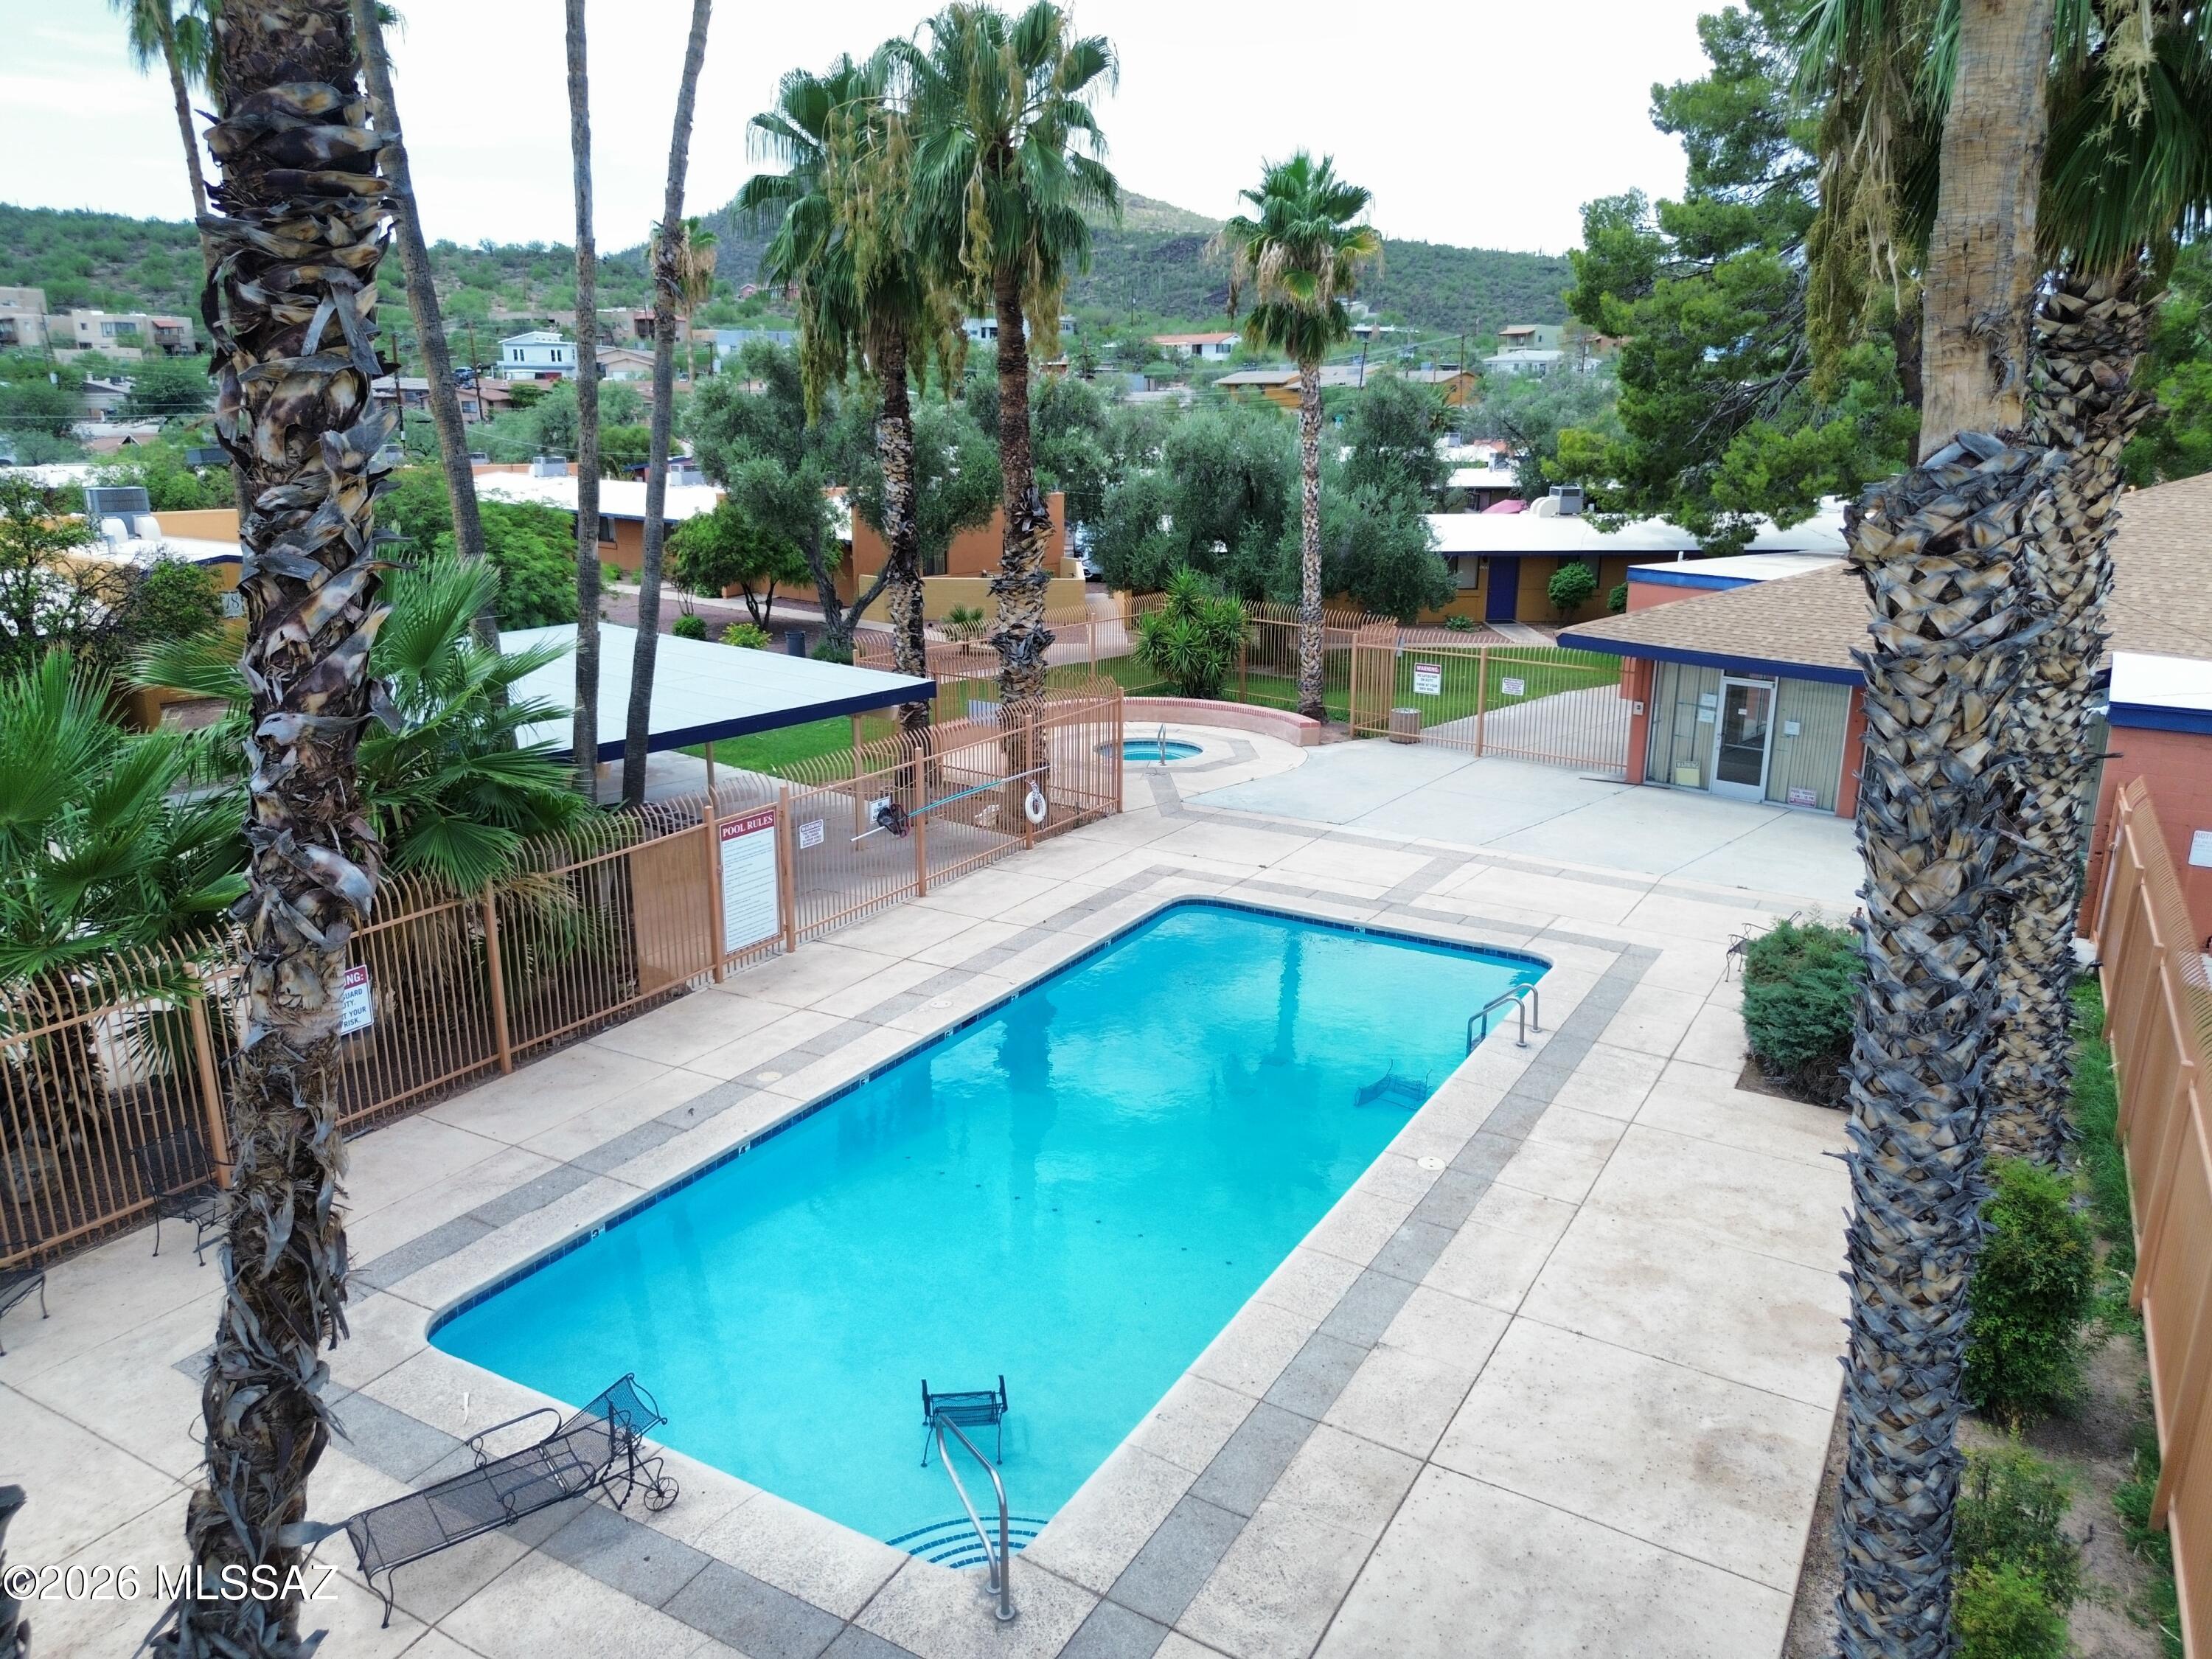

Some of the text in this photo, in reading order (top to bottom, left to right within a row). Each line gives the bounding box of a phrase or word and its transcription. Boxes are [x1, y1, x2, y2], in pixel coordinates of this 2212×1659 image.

[723, 815, 773, 837] POOL RULES
[349, 1006, 366, 1017] YOUR
[344, 1017, 361, 1028] RISK.
[740, 1145, 746, 1155] 4
[592, 1228, 599, 1239] 3
